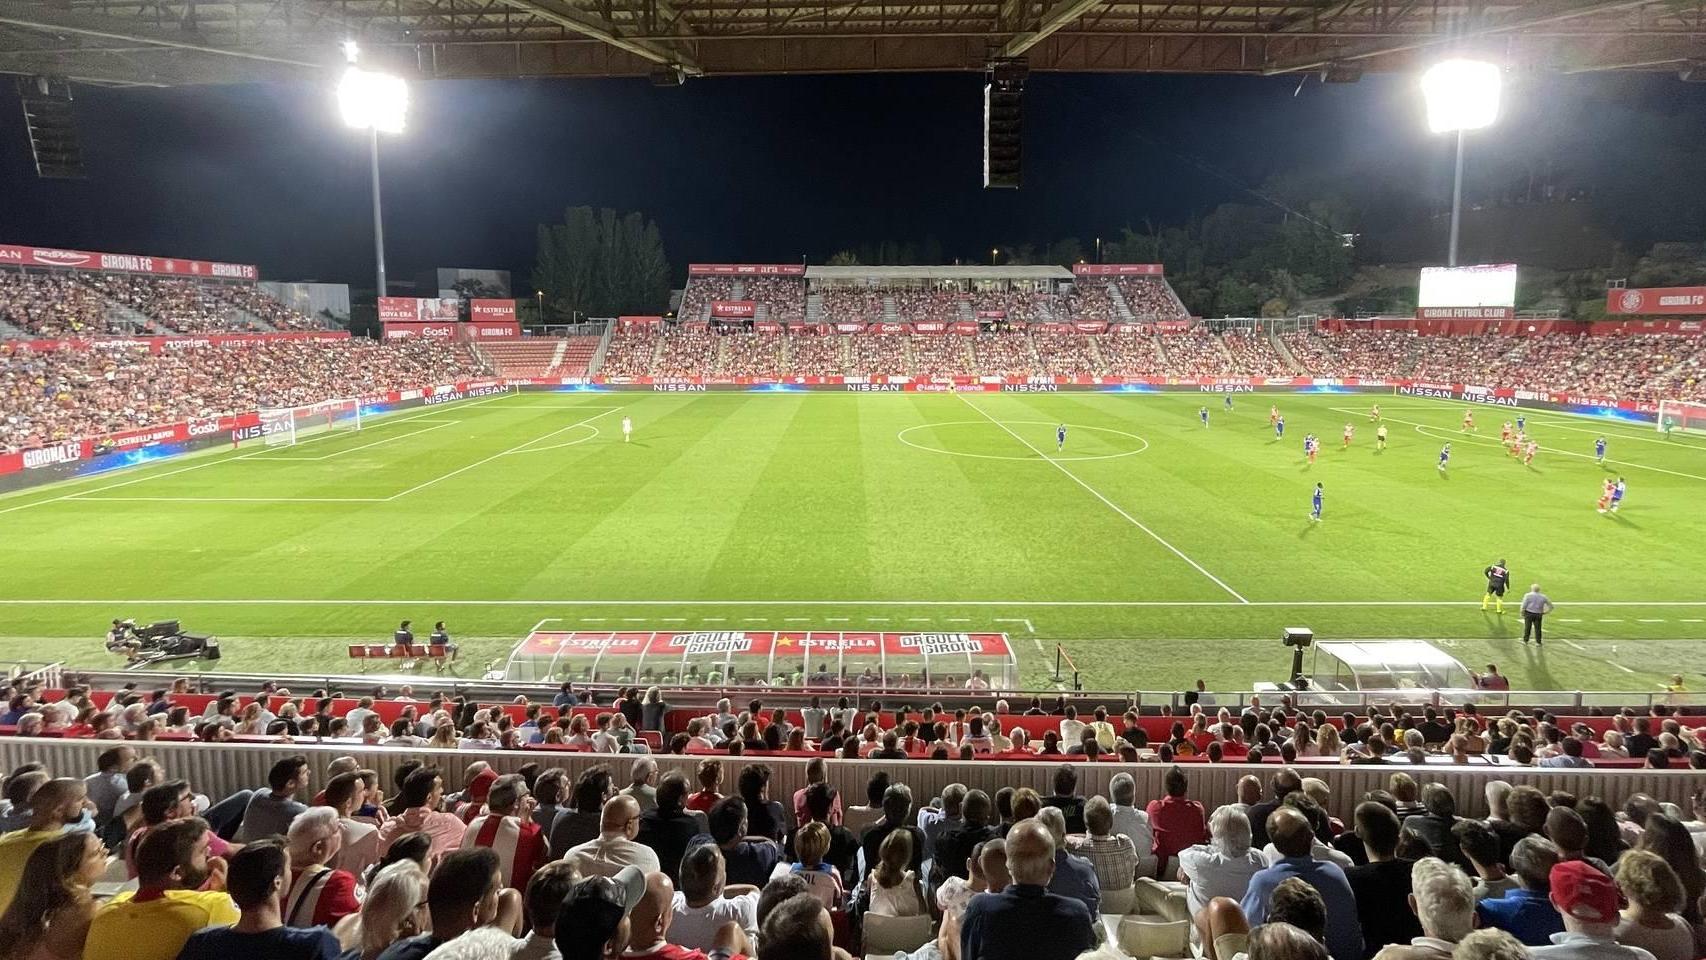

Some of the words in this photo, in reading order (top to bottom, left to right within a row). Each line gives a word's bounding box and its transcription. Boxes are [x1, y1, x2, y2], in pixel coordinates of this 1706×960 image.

[101, 255, 139, 271] GIRONA
[140, 258, 152, 271] FC
[212, 264, 241, 276] GIRONA
[242, 266, 253, 277] FC
[1692, 295, 1704, 305] FC
[1454, 308, 1482, 318] FUTBOL
[1484, 308, 1505, 318] CLUB
[469, 385, 509, 397] NISSAN
[847, 384, 899, 392] NISSAN
[1005, 384, 1057, 392] NISSAN
[1400, 387, 1451, 399] NISSAN
[424, 391, 463, 405] NISSAN
[1461, 392, 1518, 407] NISSAN
[1567, 396, 1618, 408] NISSAN
[188, 421, 219, 436] Gosbi
[232, 420, 293, 441] NISSAN
[23, 445, 66, 468] GIRONA
[67, 443, 80, 458] FC
[798, 639, 876, 647] ESTRELLA
